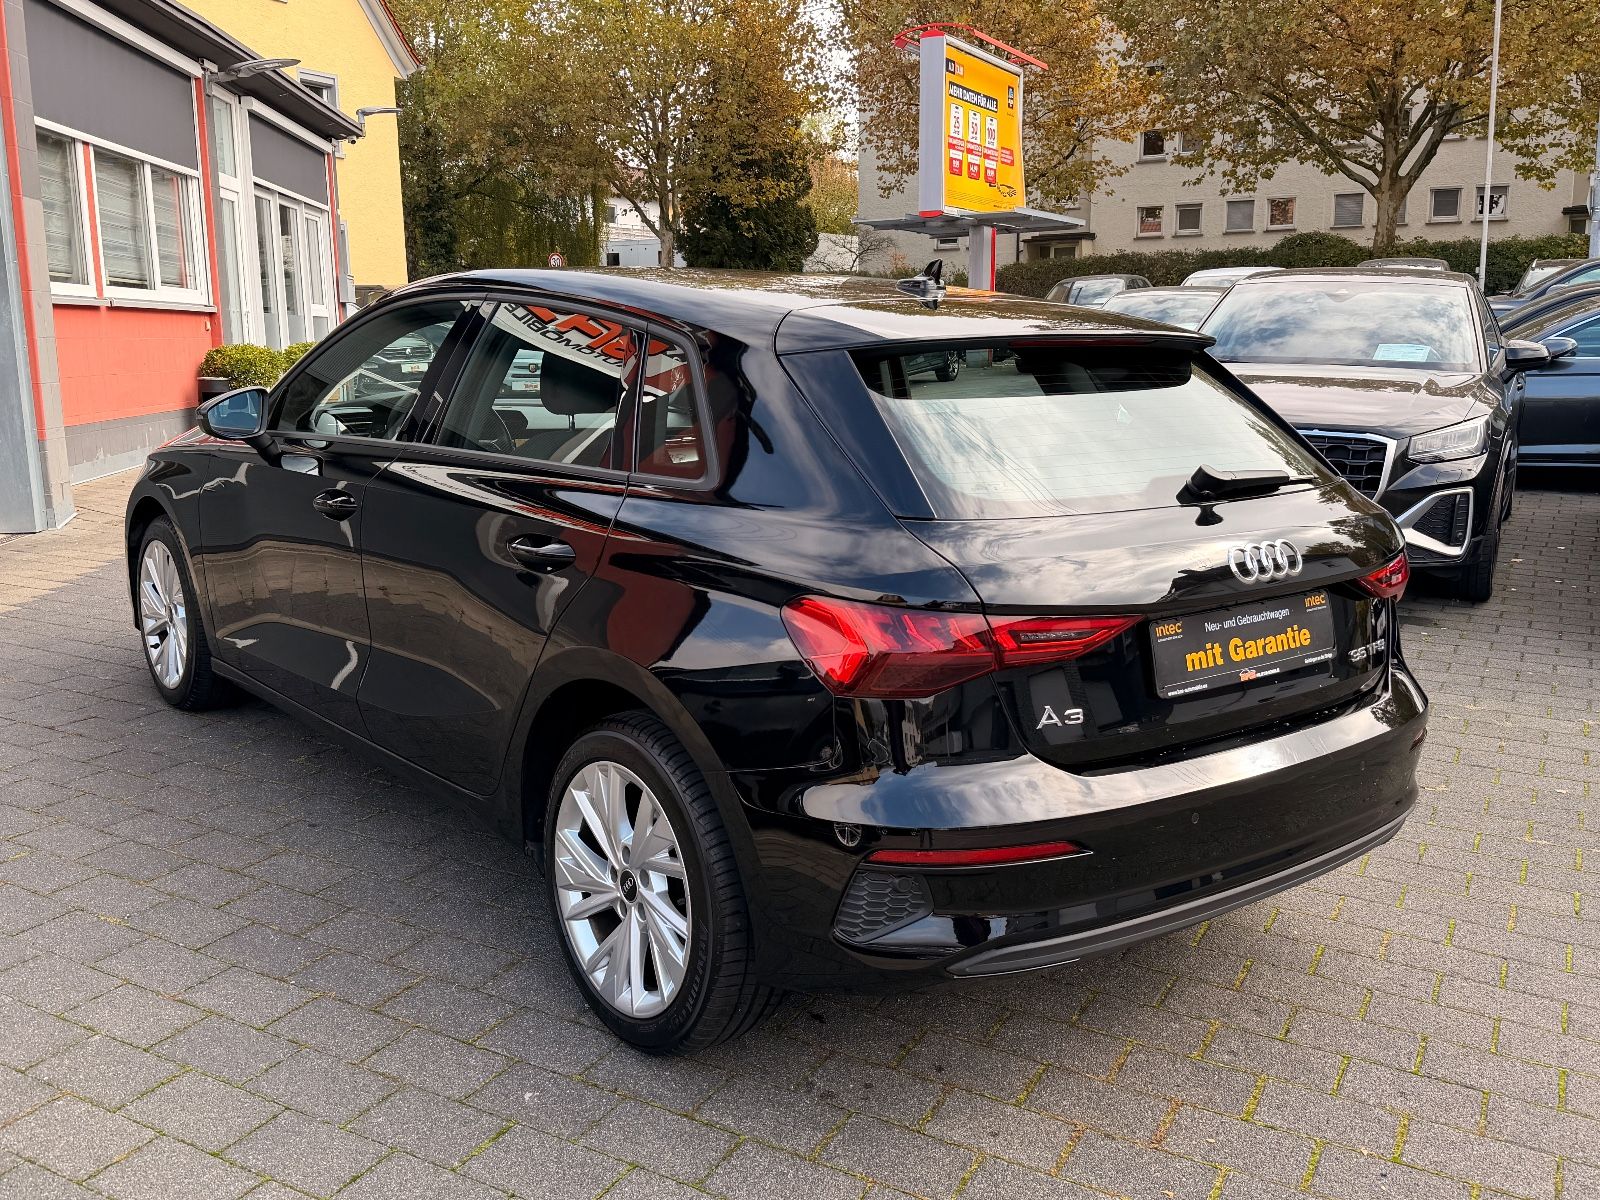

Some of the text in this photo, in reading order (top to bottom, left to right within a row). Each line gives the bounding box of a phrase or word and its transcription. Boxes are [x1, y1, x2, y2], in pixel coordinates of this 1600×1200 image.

[949, 83, 962, 99] MEHR
[963, 89, 978, 105] DATEN
[977, 94, 987, 107] FÜR
[953, 115, 961, 129] 25
[971, 121, 979, 135] 50
[987, 126, 996, 141] 100
[551, 257, 561, 267] 30
[1305, 593, 1326, 608] intec
[1205, 607, 1290, 632] Neu- und Gebrauchtwagen
[1155, 621, 1183, 637] intec
[1185, 624, 1312, 672] mit Garantie
[1036, 705, 1084, 730] A3
